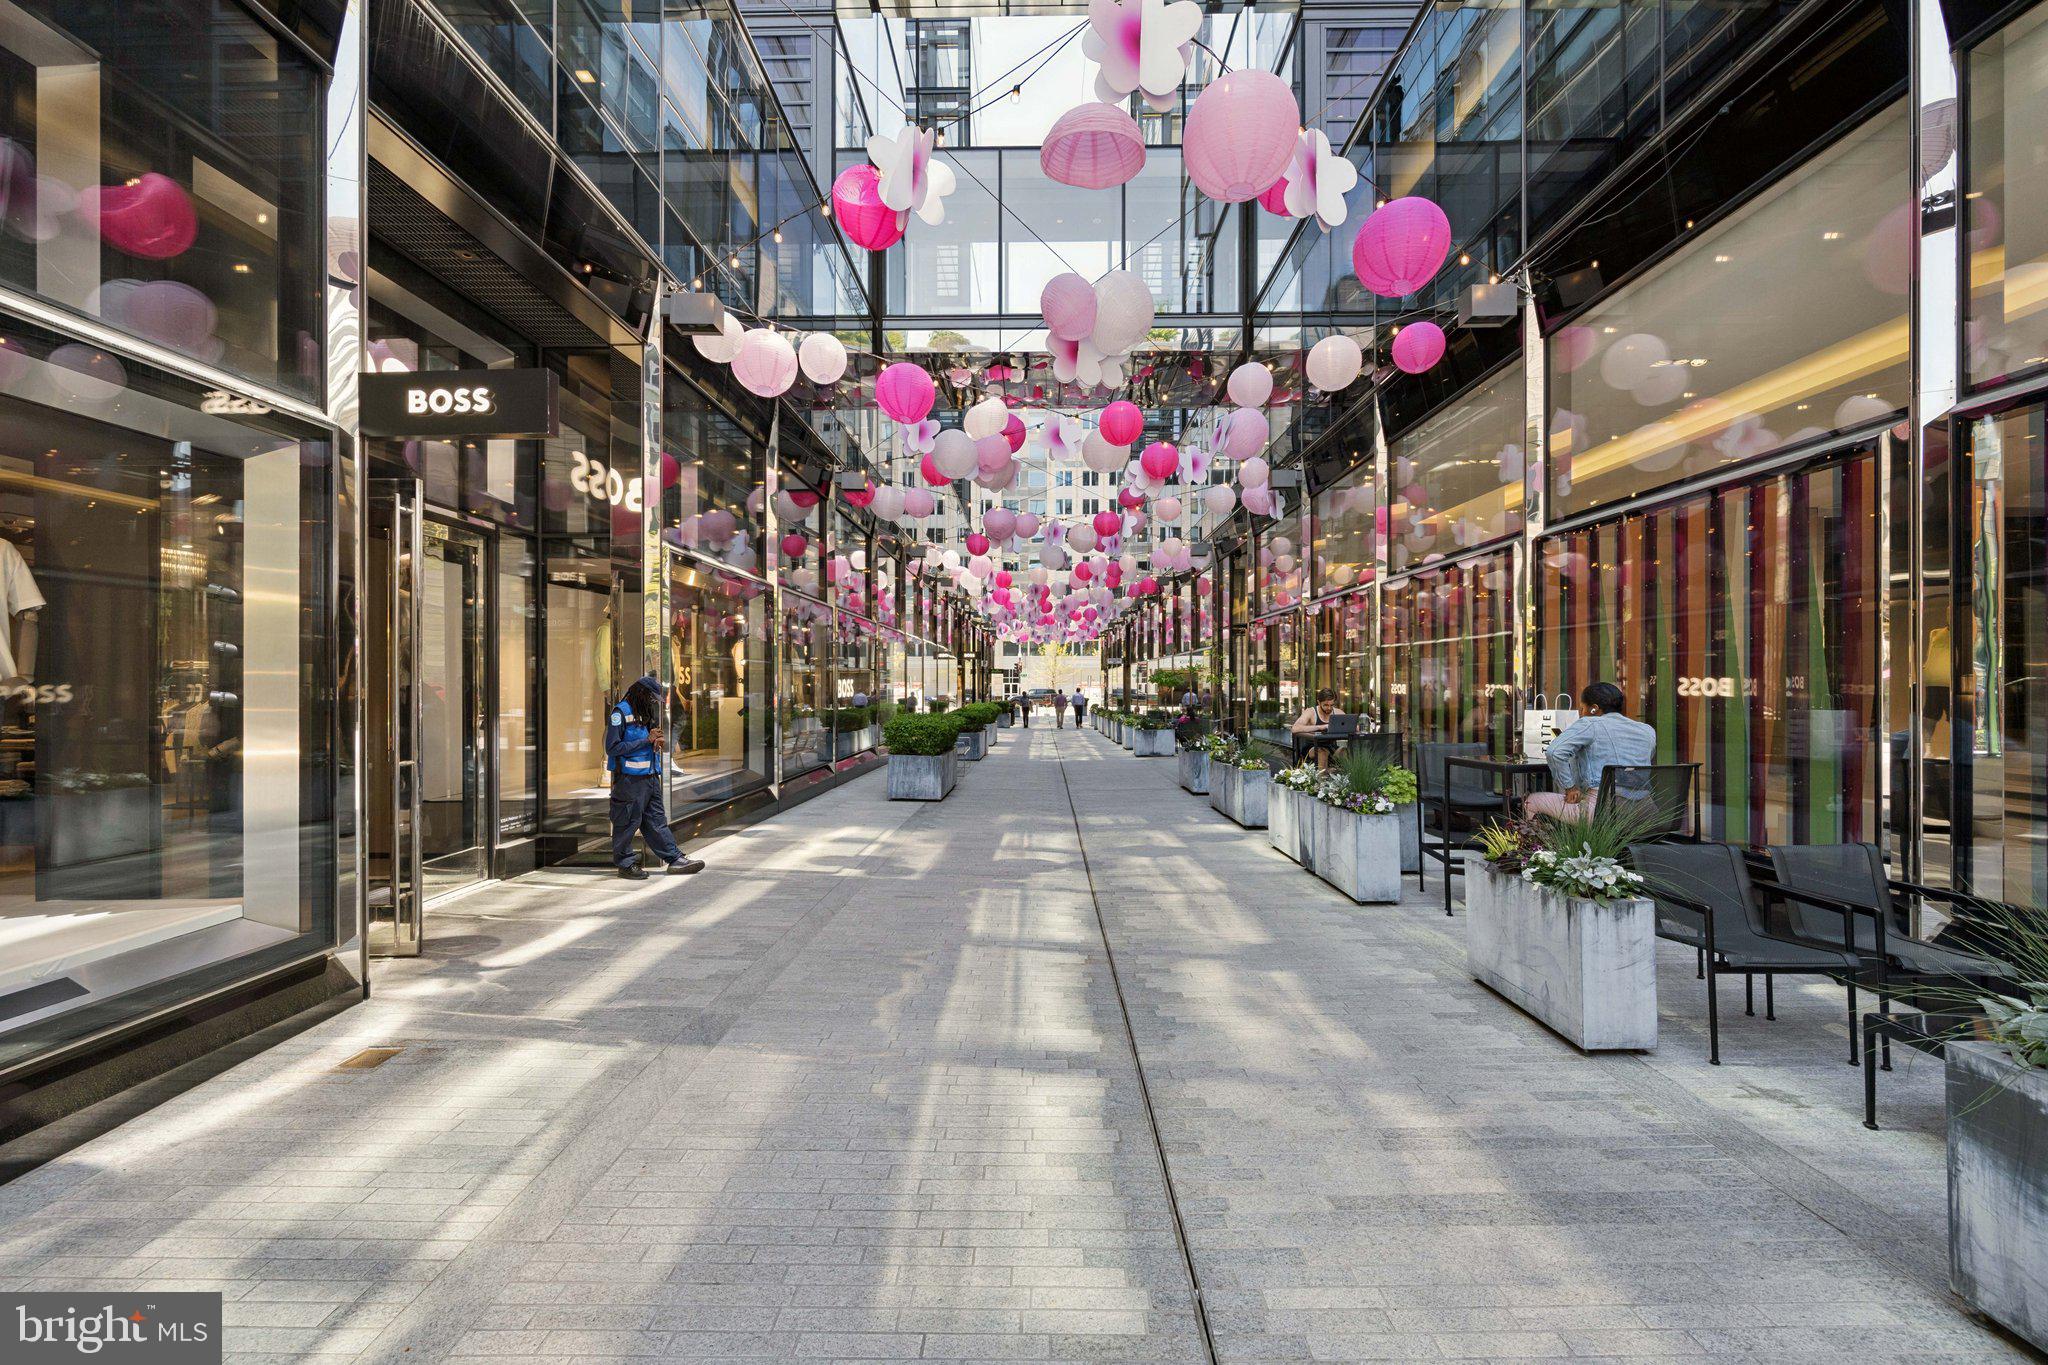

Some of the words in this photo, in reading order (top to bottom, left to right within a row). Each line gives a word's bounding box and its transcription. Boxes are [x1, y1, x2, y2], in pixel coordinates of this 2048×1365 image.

[408, 387, 490, 414] BOSS
[0, 683, 74, 704] OSS
[837, 678, 855, 698] BOSS
